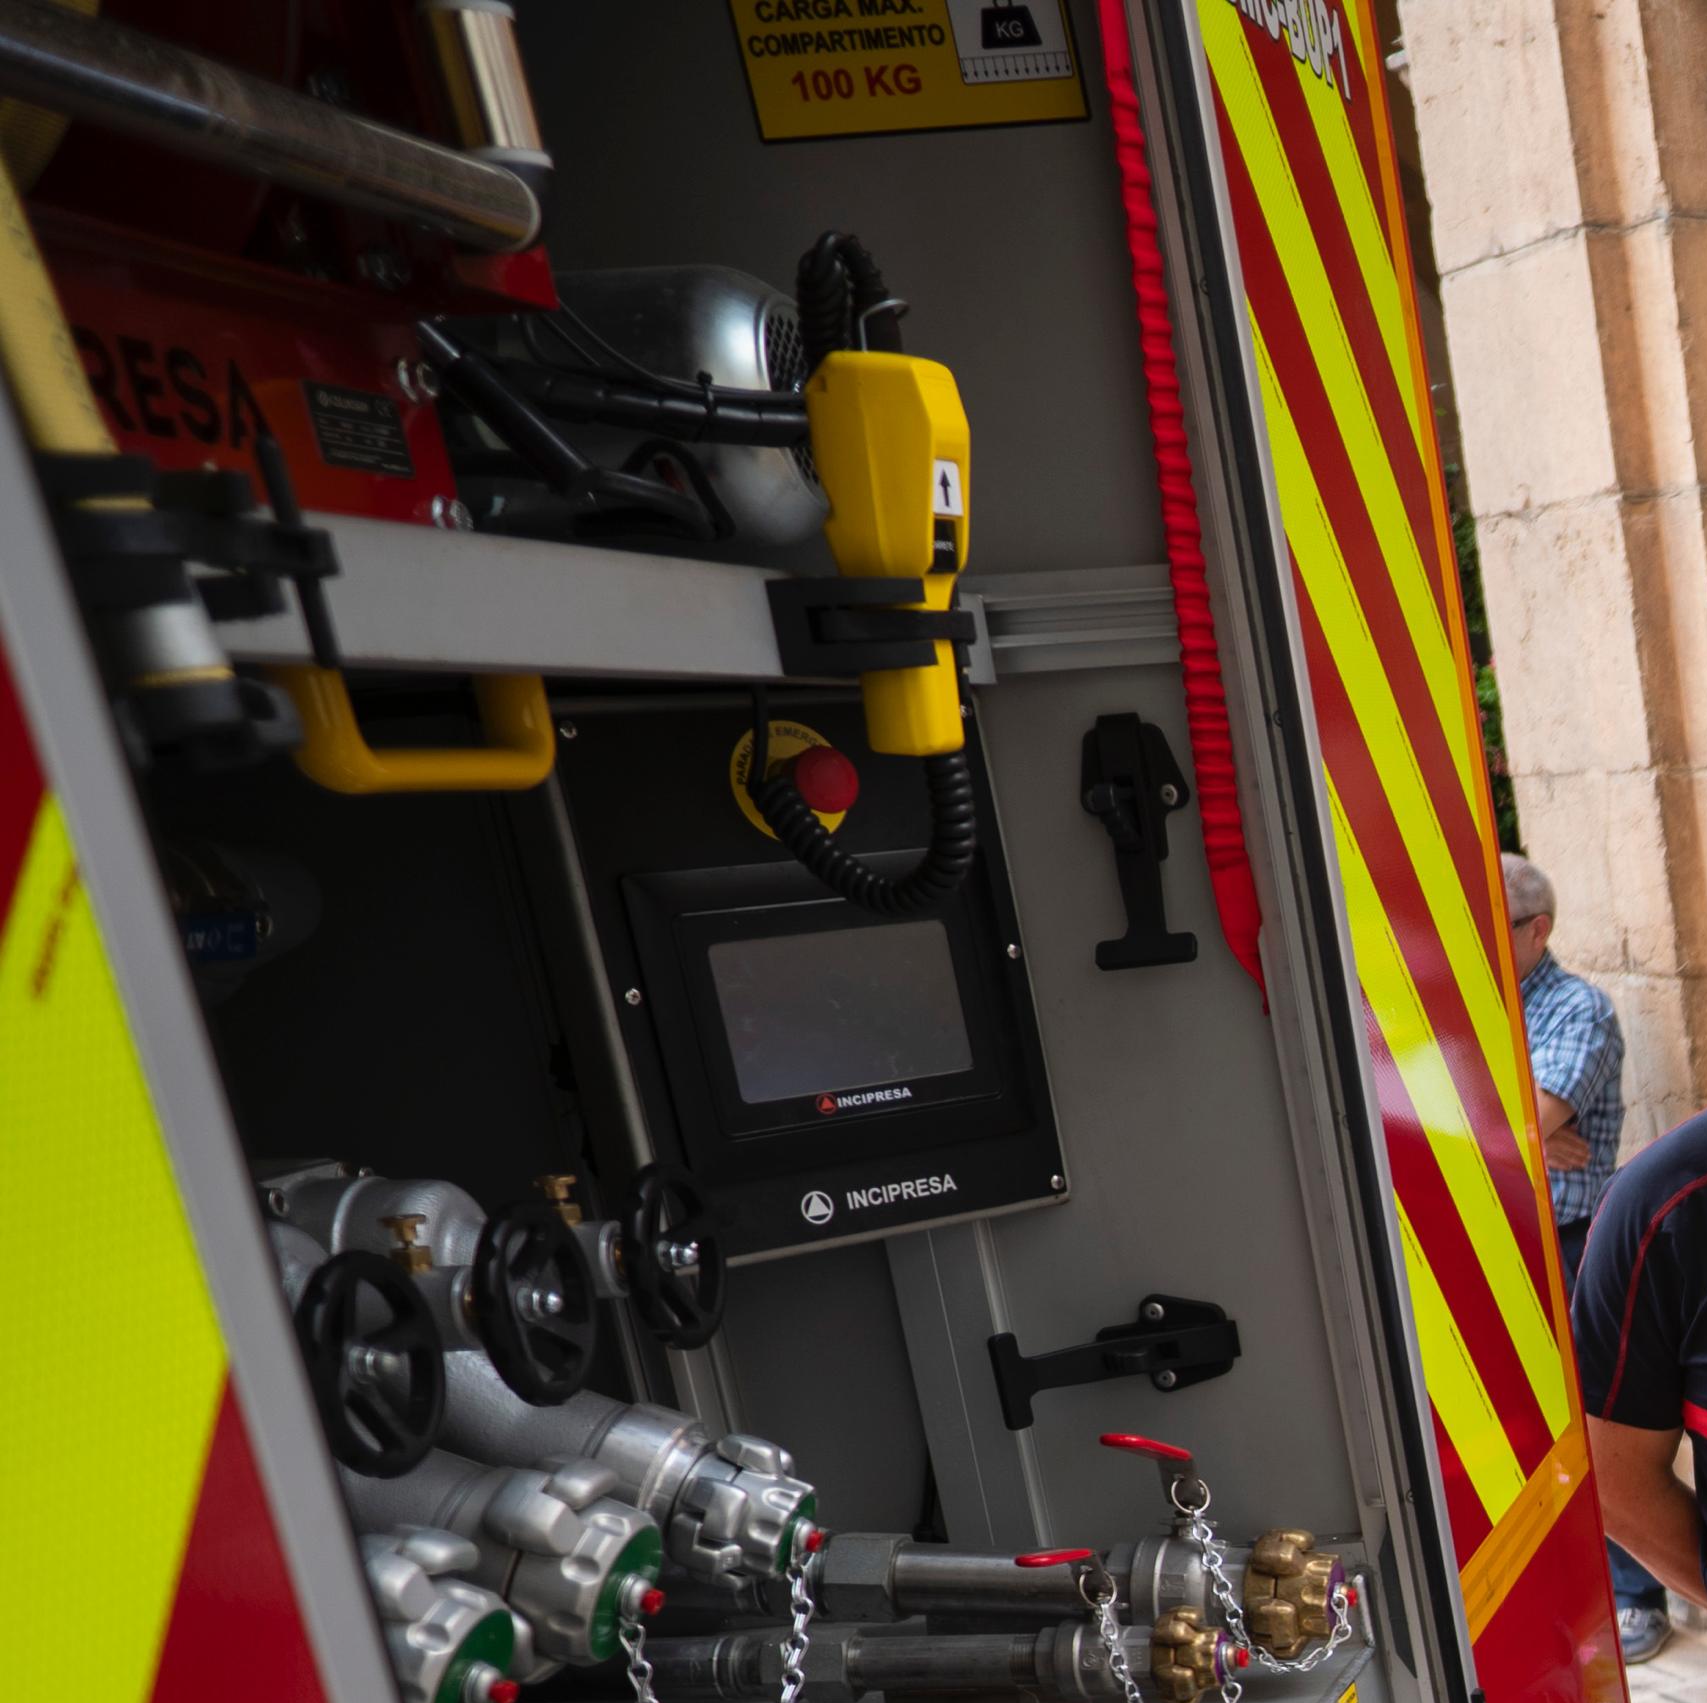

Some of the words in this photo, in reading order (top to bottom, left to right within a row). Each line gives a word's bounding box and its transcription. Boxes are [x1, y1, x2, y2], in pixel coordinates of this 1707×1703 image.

[754, 0, 852, 23] CARGA
[747, 23, 946, 58] COMPARTIMENTO
[993, 19, 1025, 39] KG
[791, 67, 855, 103] 100
[863, 63, 923, 98] KG
[836, 1086, 913, 1109] INCIPRESA
[846, 1173, 958, 1211] INCIPRESA
